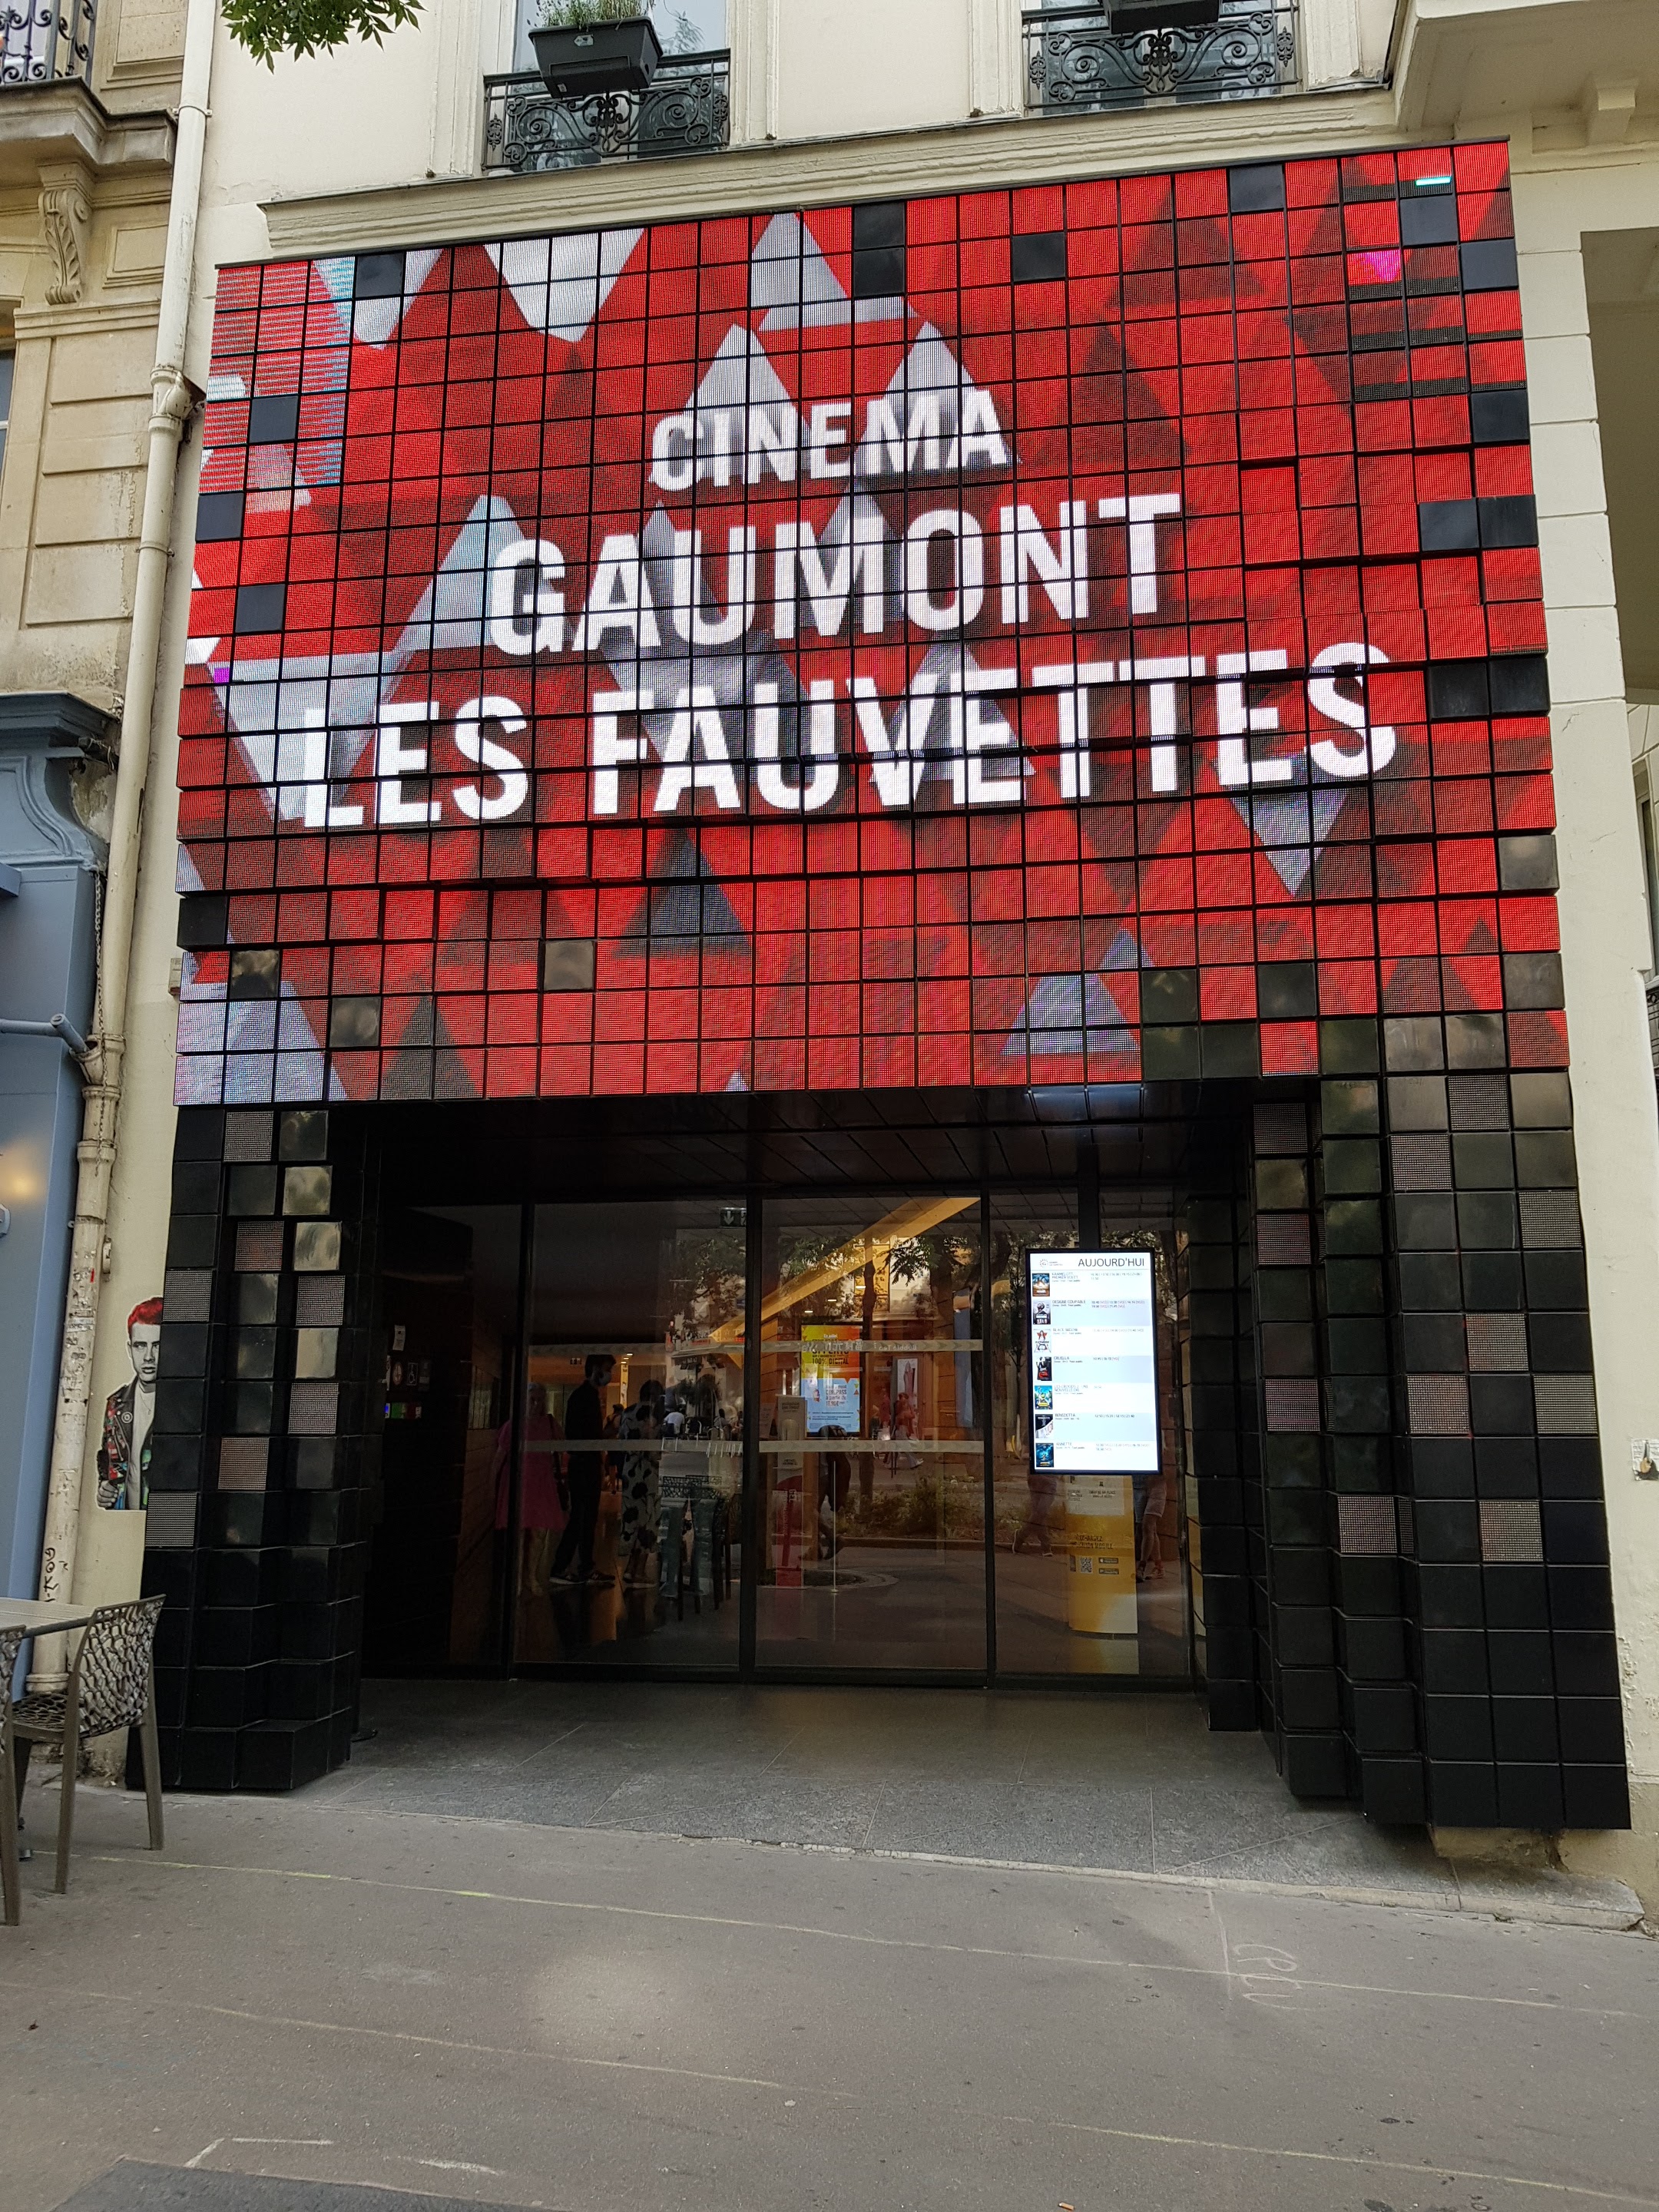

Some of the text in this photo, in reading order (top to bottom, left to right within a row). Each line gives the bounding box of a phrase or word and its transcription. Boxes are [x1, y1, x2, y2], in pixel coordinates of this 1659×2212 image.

[650, 388, 1011, 492] CINEMA
[488, 493, 1182, 656] GAUMONT
[303, 641, 1398, 829] LES FAUVETTES
[1078, 1257, 1144, 1267] AUJOURD'HUI
